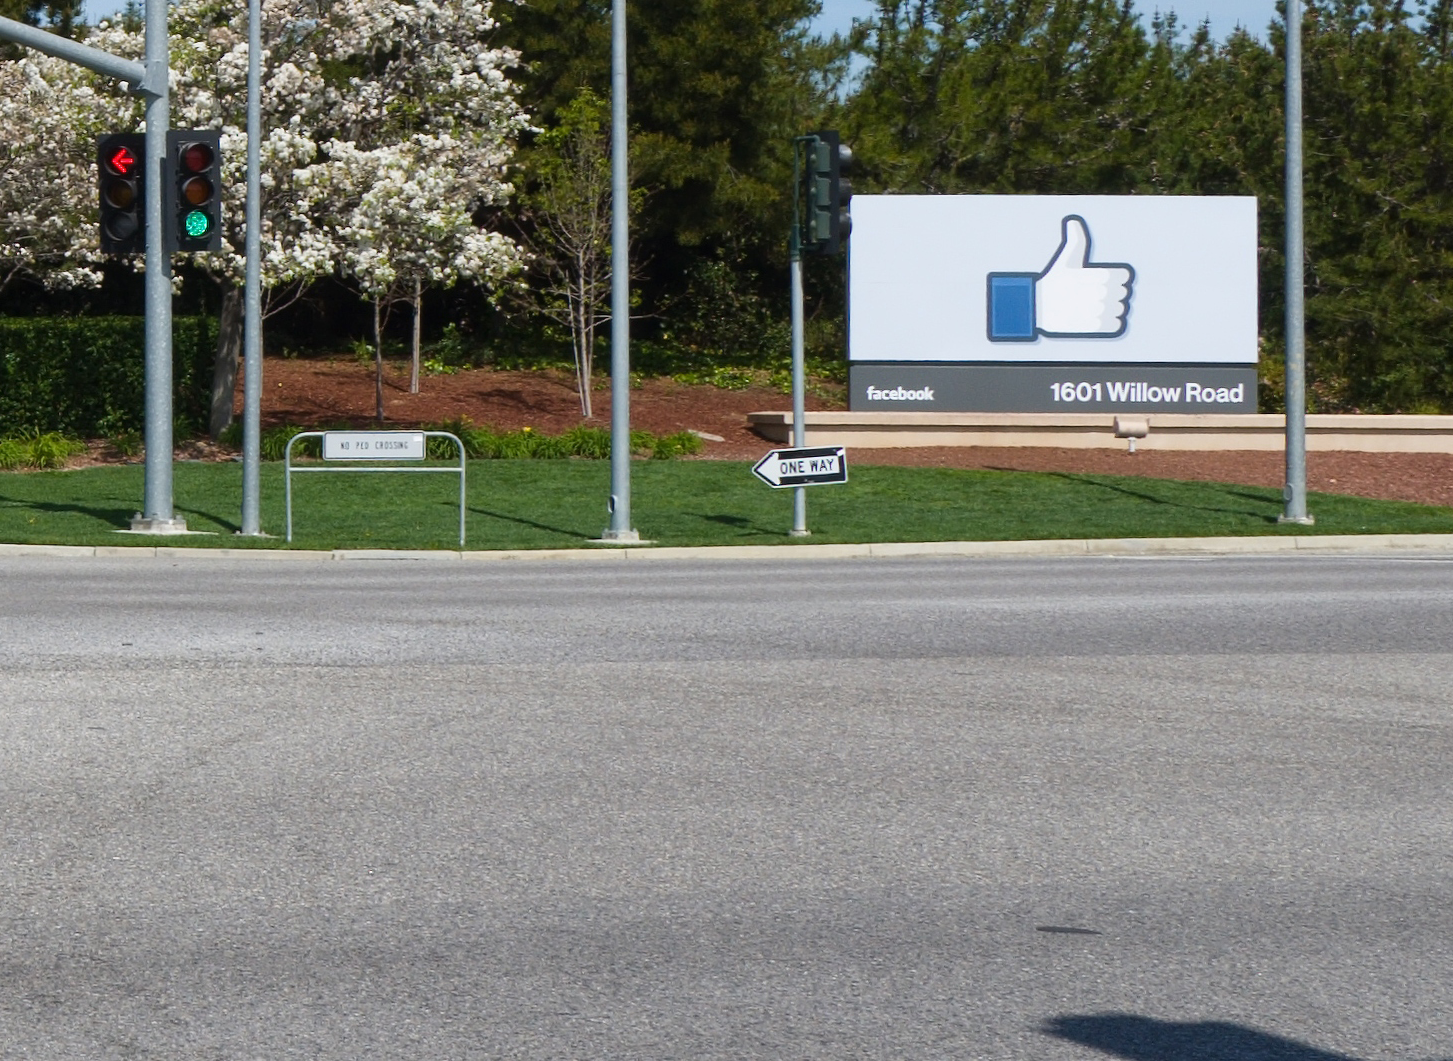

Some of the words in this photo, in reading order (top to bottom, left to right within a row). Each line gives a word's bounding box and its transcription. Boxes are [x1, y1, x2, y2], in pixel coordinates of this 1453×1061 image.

[866, 385, 935, 401] facebook
[1050, 382, 1102, 402] 1601
[1106, 381, 1181, 403] Willow
[1185, 382, 1244, 403] Road
[340, 441, 350, 450] NO
[355, 441, 369, 450] PED
[374, 441, 409, 450] CROSSING
[780, 460, 805, 475] ONE
[809, 458, 834, 472] WAY
